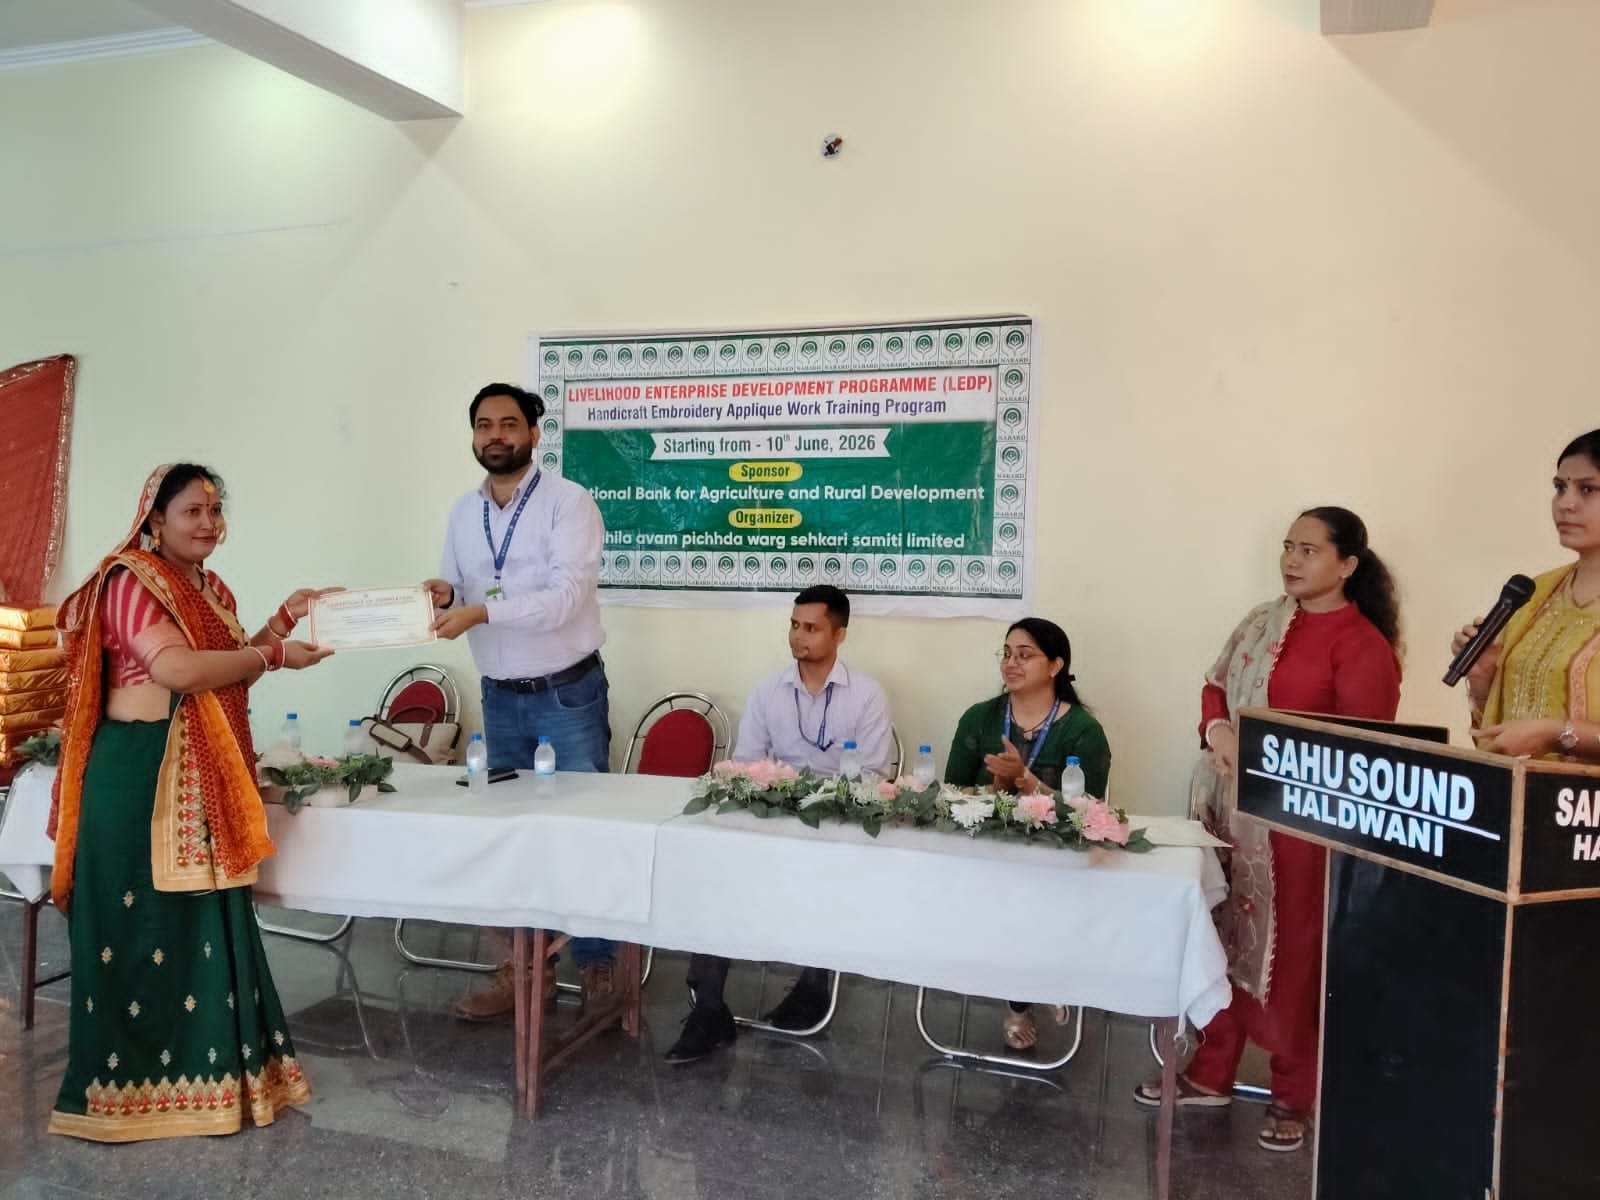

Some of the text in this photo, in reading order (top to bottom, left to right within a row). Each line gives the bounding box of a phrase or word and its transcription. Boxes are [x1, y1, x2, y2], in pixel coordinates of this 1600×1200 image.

[568, 375, 993, 402] LIVELIHOOD ENTERPRISE DEVELOPMENT PROGRAMME (LEDP)
[588, 398, 946, 421] Handicraft Embroidery Applique Work Training Program
[664, 437, 715, 455] Starting
[720, 437, 751, 453] from
[767, 434, 790, 452] 10th
[795, 435, 833, 453] June,
[839, 434, 876, 450] 2026
[741, 465, 790, 480] Sponsor
[590, 485, 985, 503] tional Bank for Agriculture and Rural Development
[736, 511, 794, 526] Organizer
[605, 530, 965, 549] hila avam pichhda warg sehkari samiti limited
[1262, 734, 1475, 822] SAHU SOUND
[1282, 784, 1443, 857] HALDWANI
